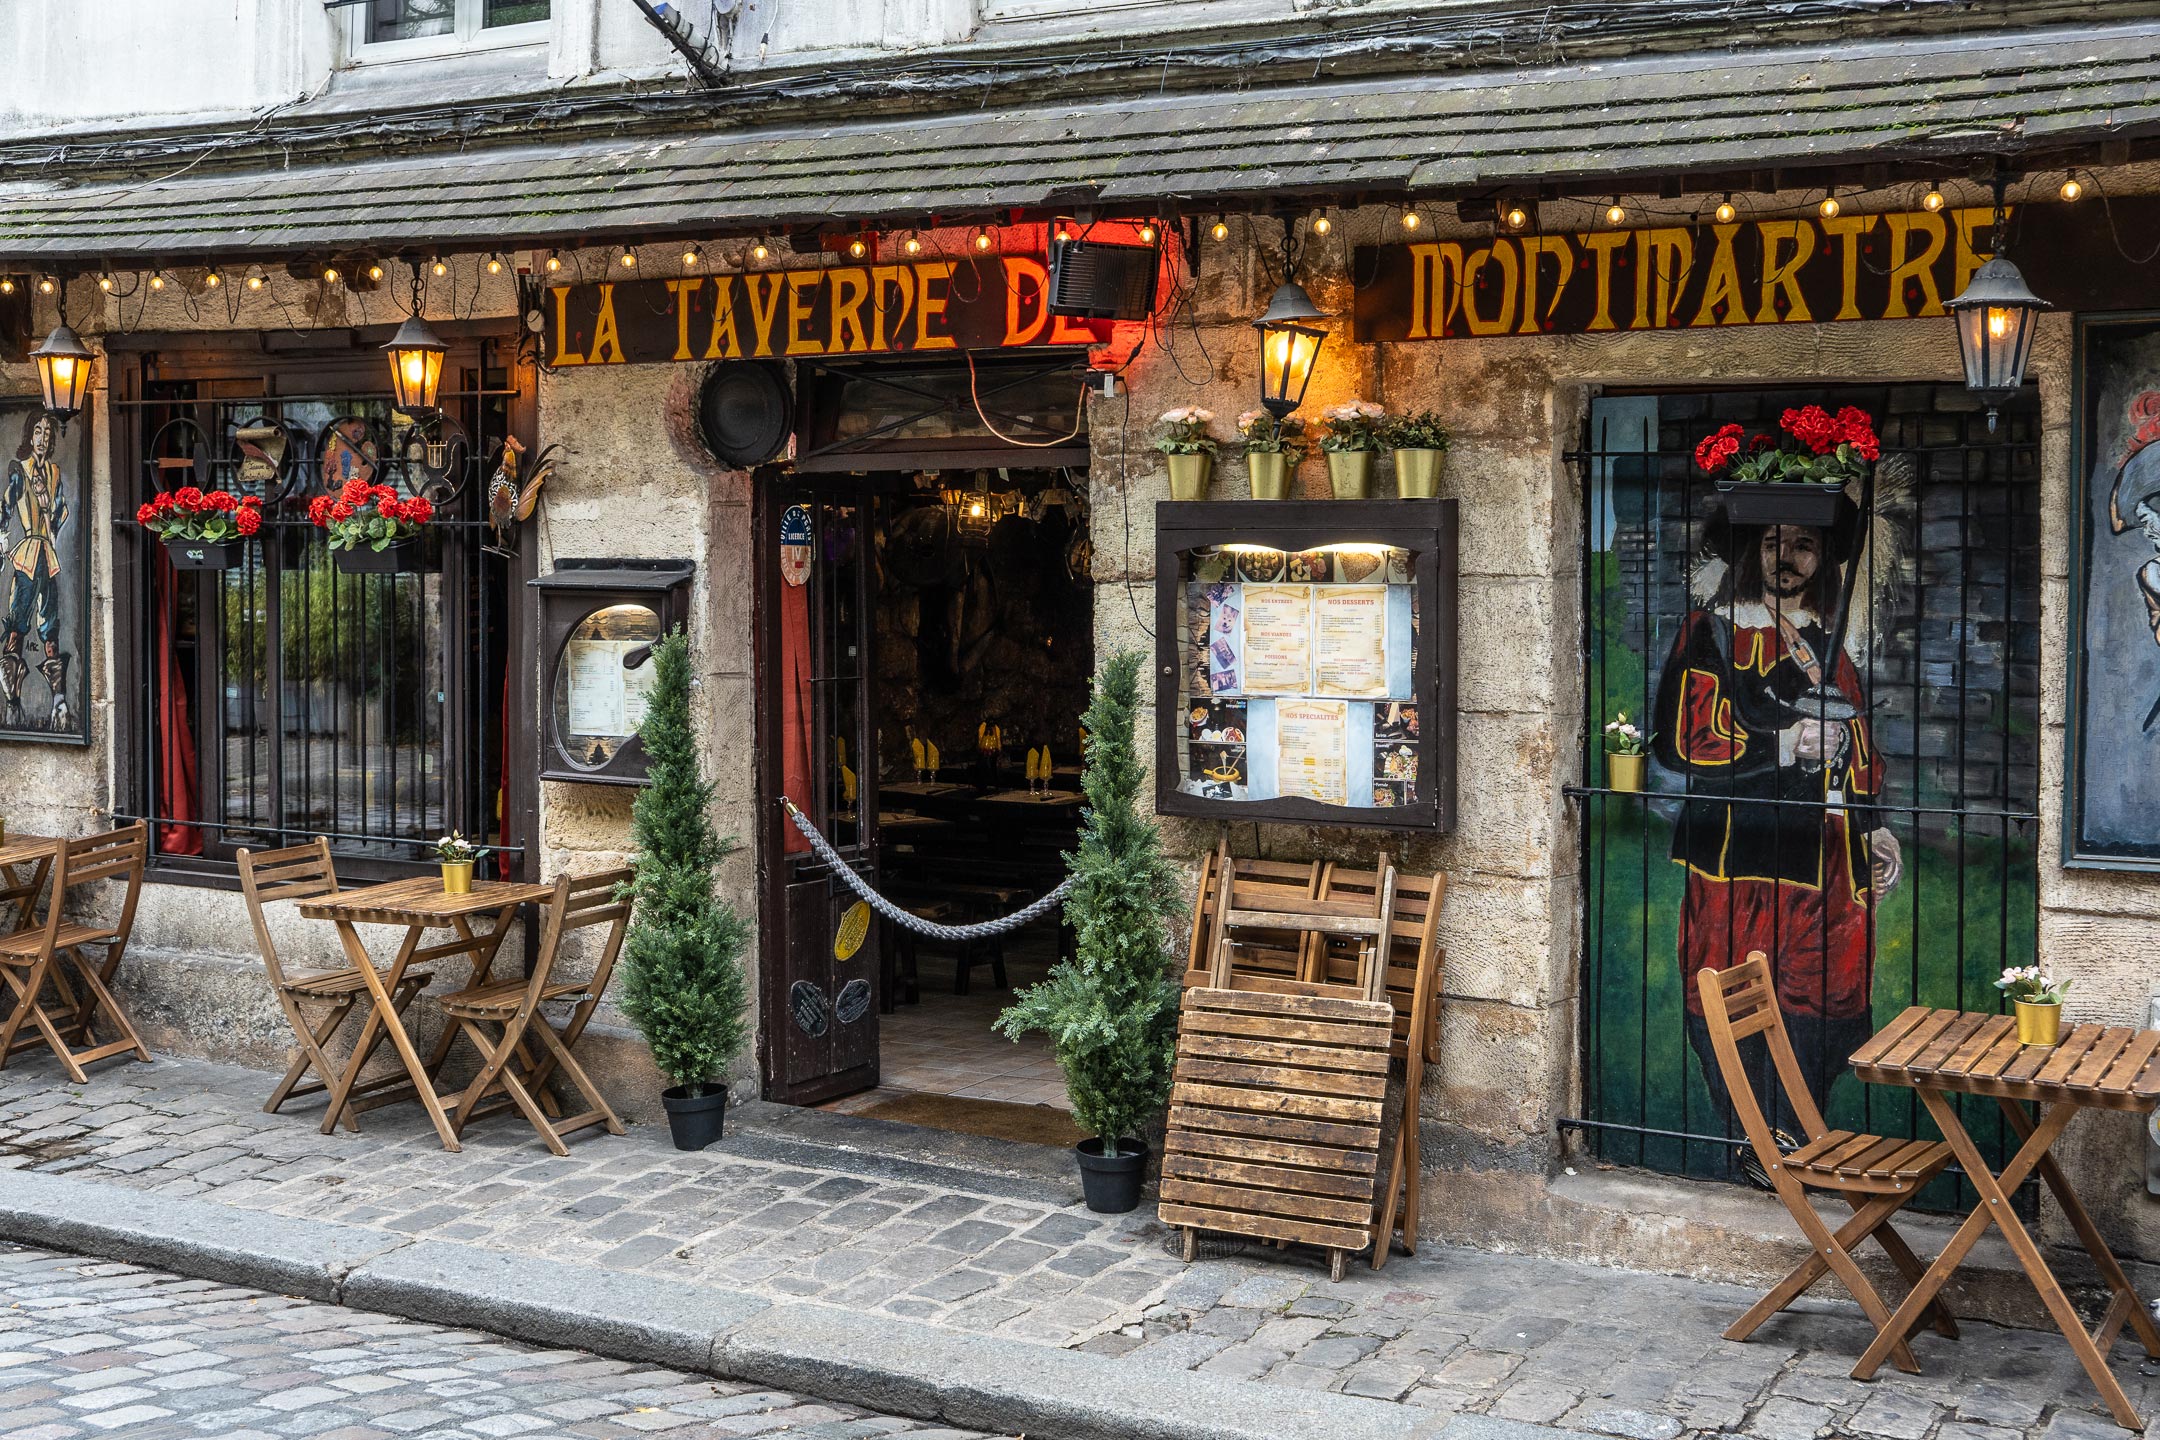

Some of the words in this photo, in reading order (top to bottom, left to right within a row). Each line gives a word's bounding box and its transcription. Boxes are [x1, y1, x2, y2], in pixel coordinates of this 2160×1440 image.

[551, 283, 626, 367] LA
[666, 262, 959, 361] TAVERNE
[1001, 256, 1097, 347] D
[1408, 206, 2015, 338] MONTMARTRE
[788, 532, 805, 541] LICENCE
